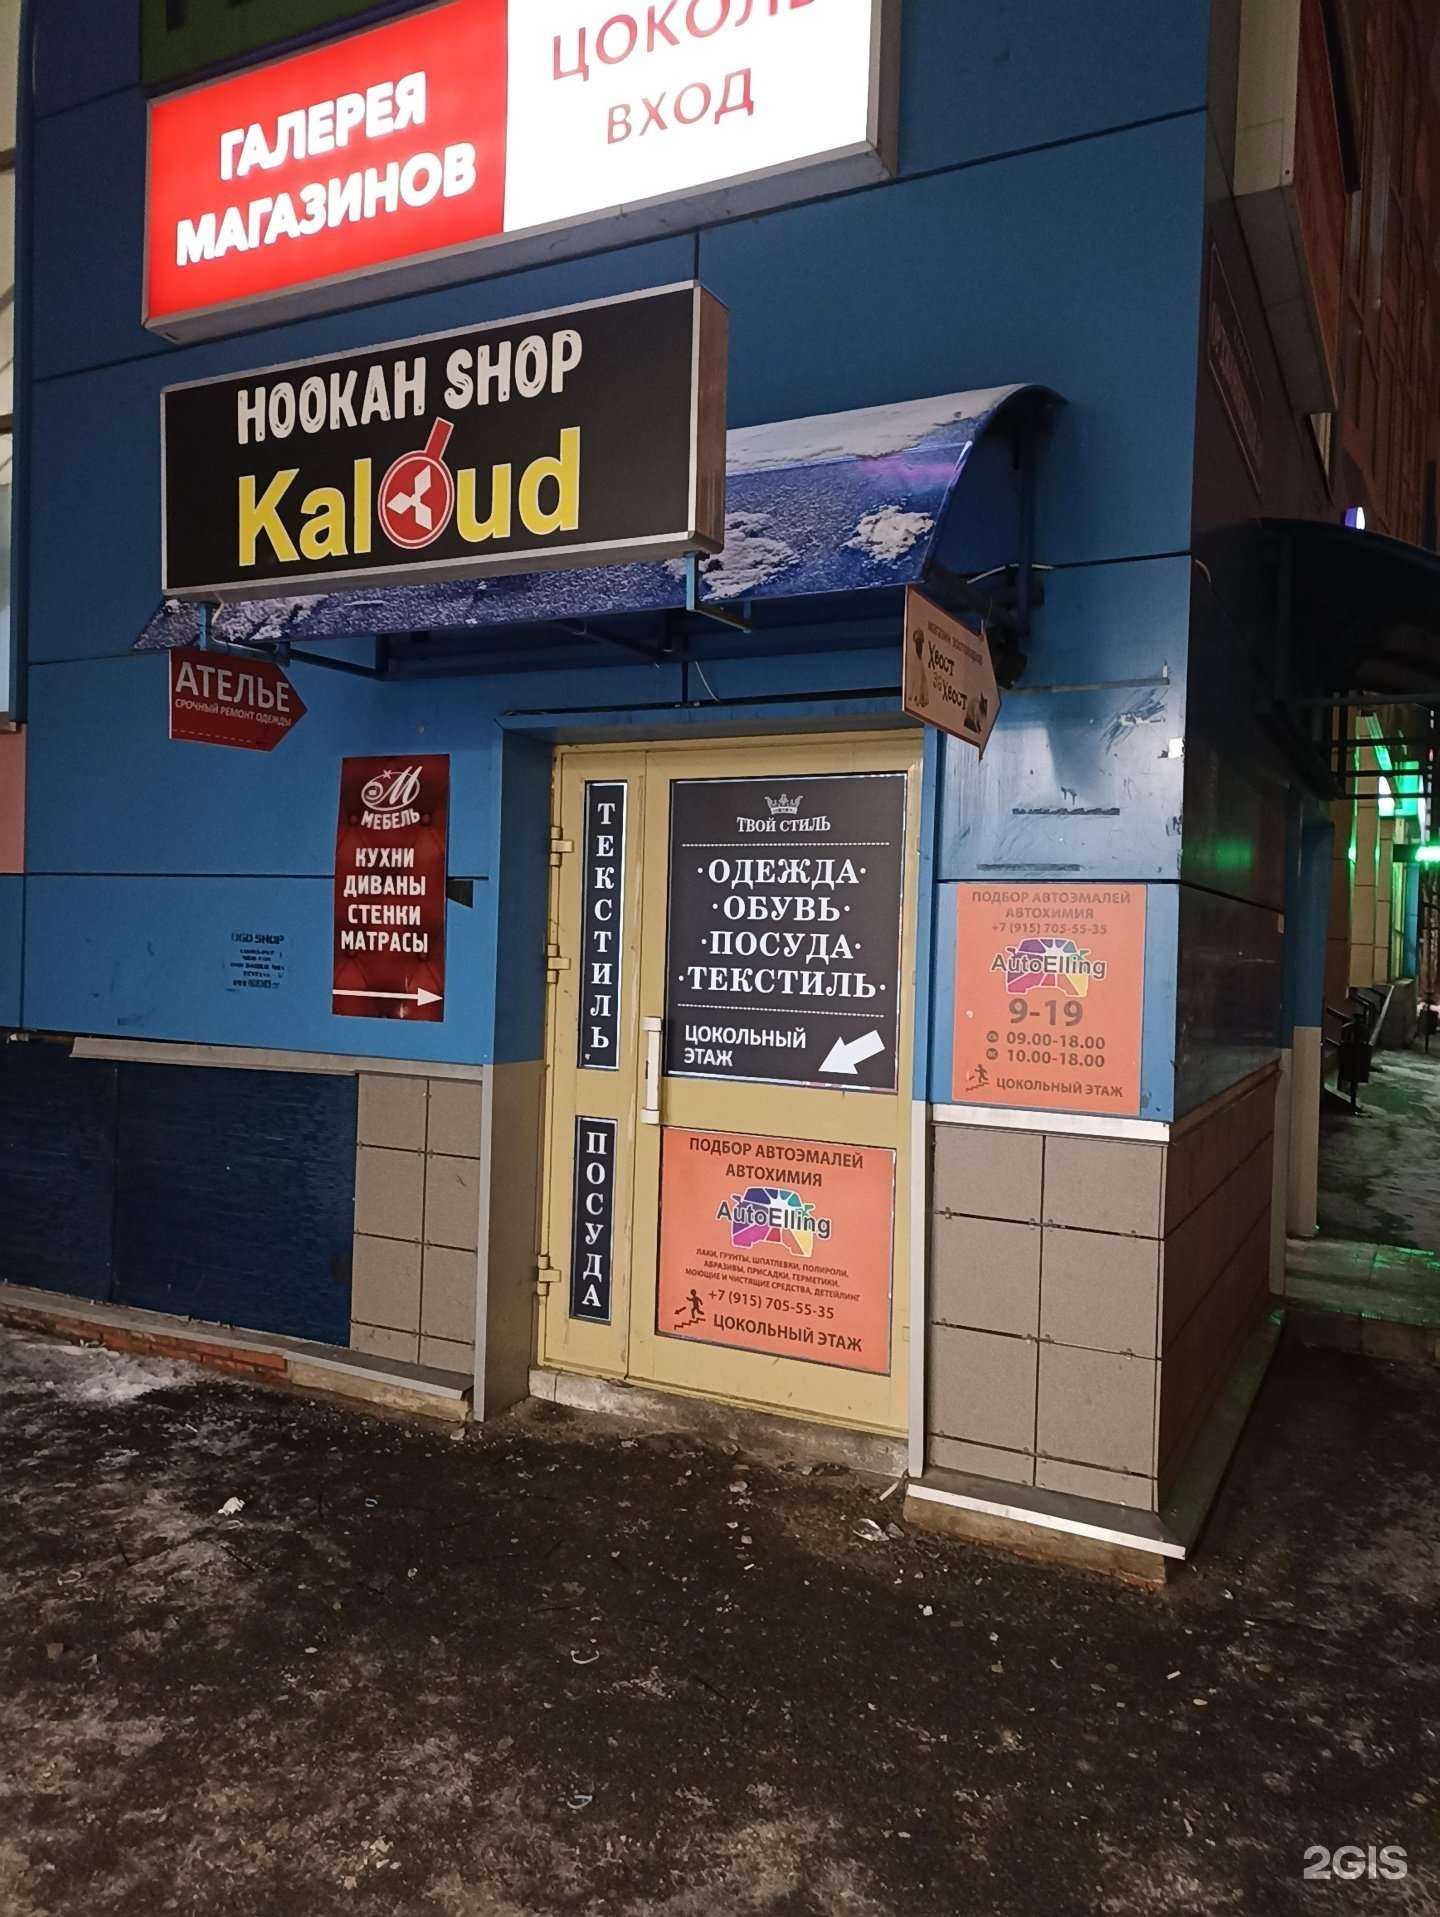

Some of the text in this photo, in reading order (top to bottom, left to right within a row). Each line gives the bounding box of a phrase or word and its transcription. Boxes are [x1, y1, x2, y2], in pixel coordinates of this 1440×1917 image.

[552, 0, 815, 82] ЦОКОЛ
[606, 67, 755, 146] ВХОД
[220, 71, 427, 182] ГАЛЕРЕЯ
[175, 142, 477, 267] МАГАЗИНОВ
[237, 329, 583, 445] HOOKAH SHOP
[238, 417, 581, 568] Kaloud
[175, 661, 290, 713] АТЕЛЬЕ
[175, 698, 292, 727] СРОЧНЫЙ РЕМОНТ ОДЕЖДЫ
[360, 809, 420, 830] МЕБЕЛЬ
[736, 815, 831, 833] ТВОЙ СТИЛЬ
[355, 848, 415, 868] КУХНИ
[343, 876, 426, 897] ДИВАНЫ
[972, 890, 1131, 904] ПОДБОР АВТОЭМАЛЕЙ
[348, 904, 420, 926] СТЕНКИ
[590, 803, 616, 1048] ТЕКСТИЛЬ
[1005, 908, 1094, 920] АВТОХИМИЯ
[340, 931, 428, 953] МАТРАСЫ
[992, 923, 1107, 934] +7 (915) 705-55-35
[991, 955, 1107, 979] AutoElling
[1008, 998, 1084, 1027] 9-19
[685, 1024, 806, 1049] ЦОКОЛЬНЫЙ
[1006, 1031, 1106, 1050] 09.00-18.00
[684, 1048, 733, 1067] ЭТАЖ
[1007, 1050, 1106, 1067] 10.00-18.00
[996, 1077, 1123, 1098] ЦОКОЛЬНЫЙ ЭТАЖ
[689, 1137, 864, 1169] ПОДБОР АВТОЭМАЛЕЙ
[725, 1163, 822, 1187] АВТОХИМИЯ
[581, 1132, 608, 1308] ПОСУДА
[716, 1200, 831, 1240] AutoElling
[685, 1268, 720, 1280] МОЮЩИЕ
[728, 1275, 770, 1289] ЧИСТЯЩИЕ
[814, 1288, 860, 1301] ДЕТЕЙЛИНГ
[709, 1289, 835, 1319] +7 (915) 705-55-35
[713, 1313, 862, 1352] ЦОКОЛЬНЫЙ ЭТАЖ
